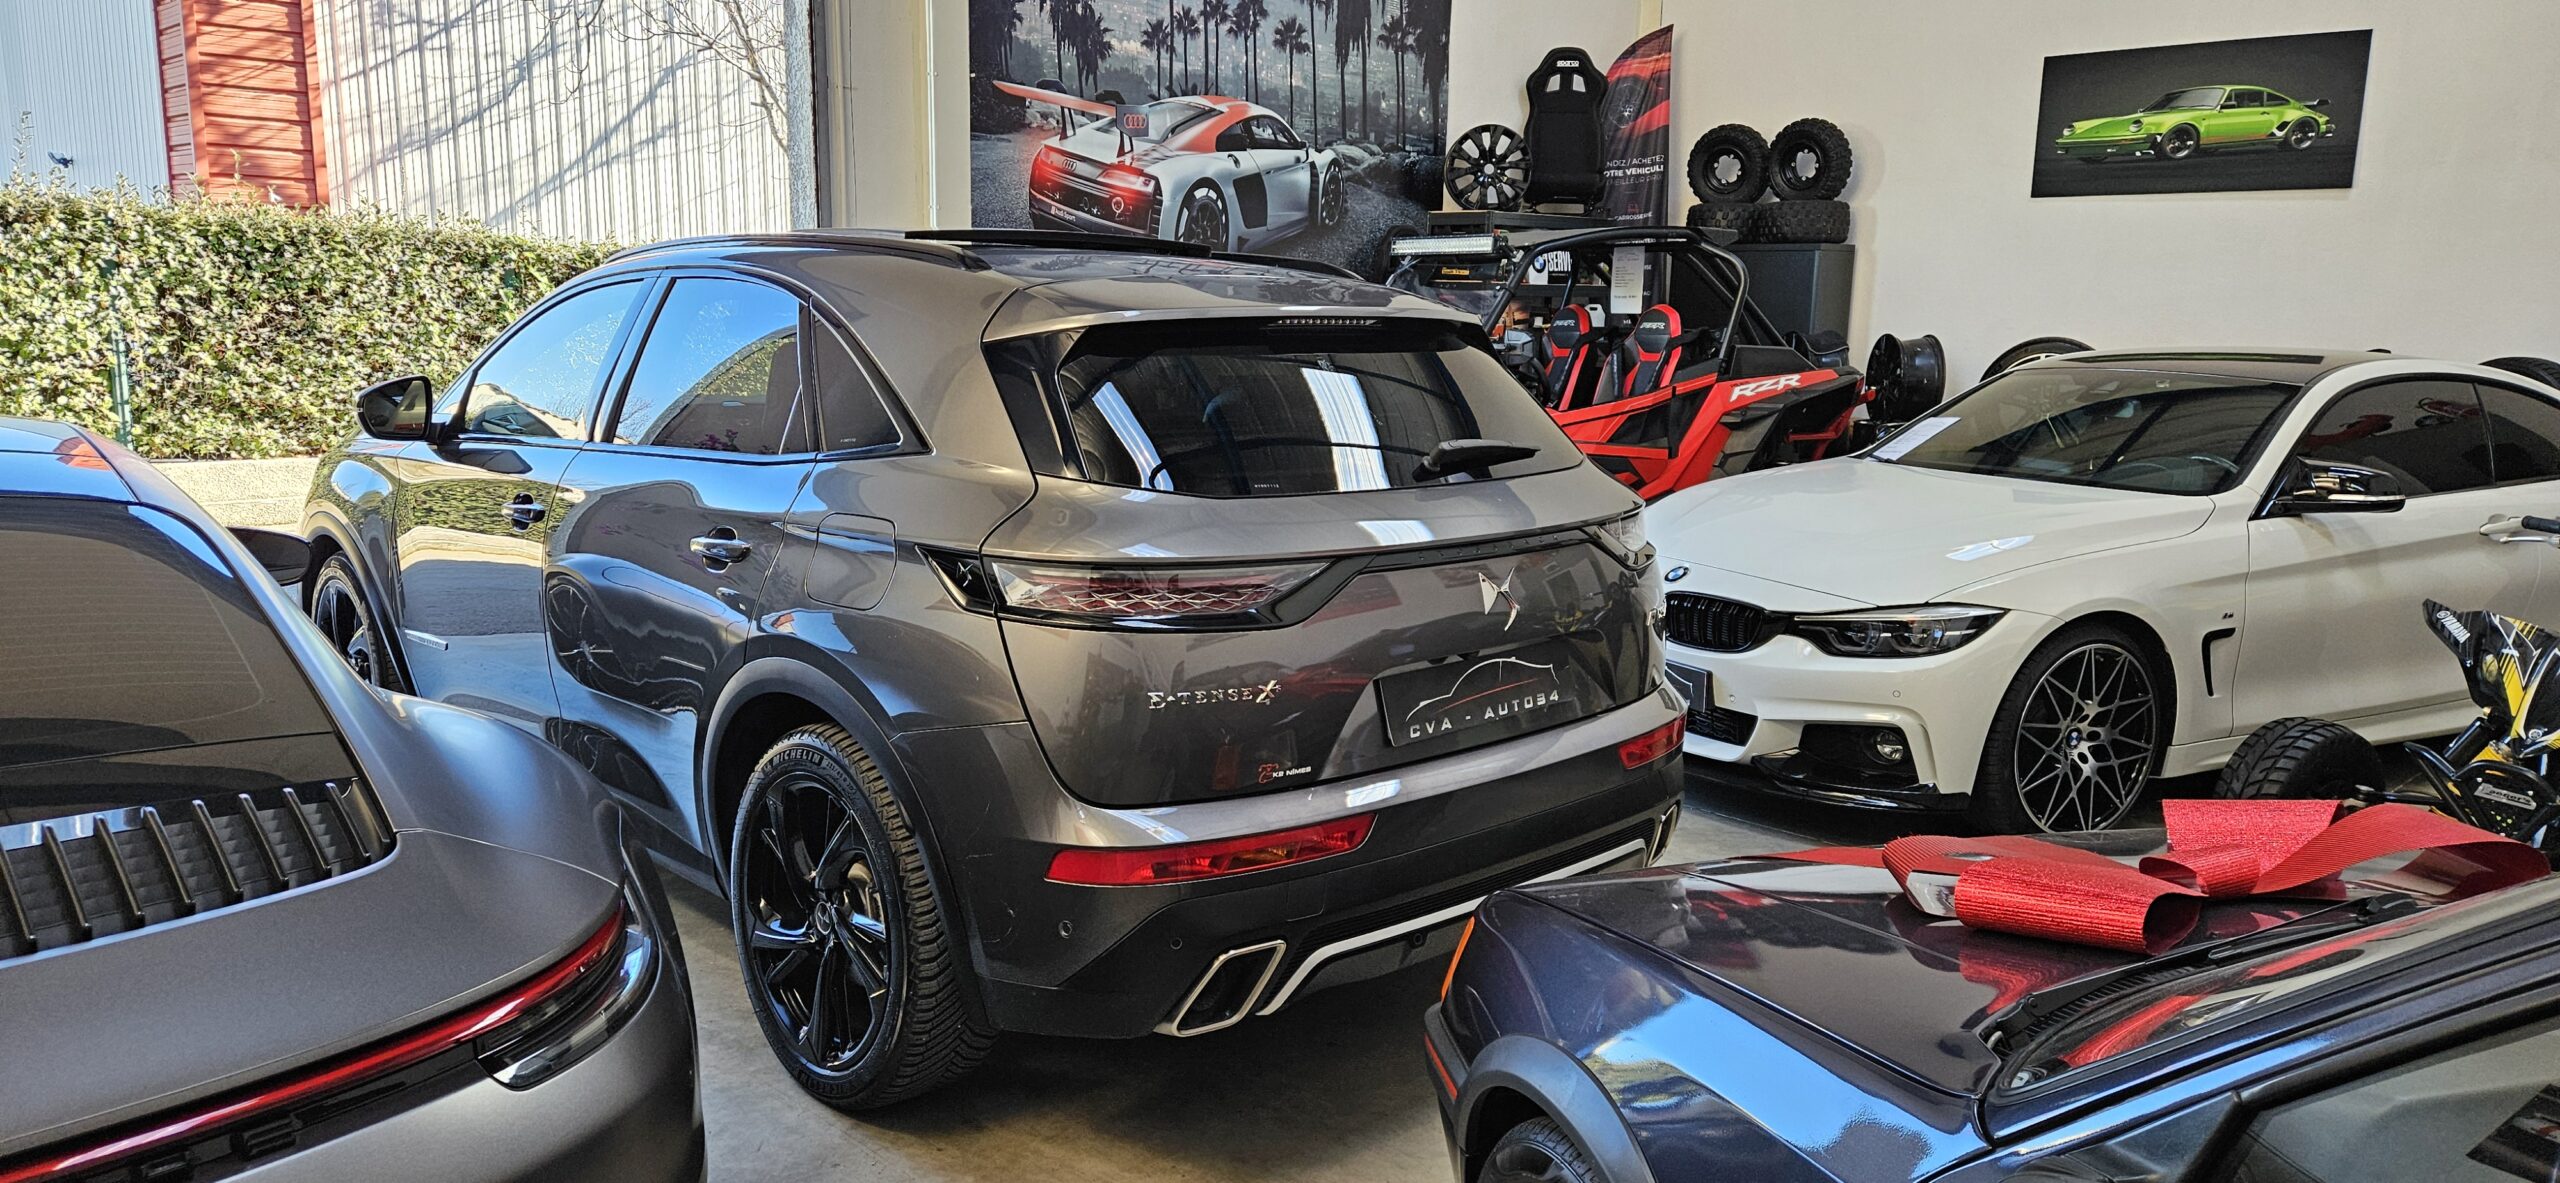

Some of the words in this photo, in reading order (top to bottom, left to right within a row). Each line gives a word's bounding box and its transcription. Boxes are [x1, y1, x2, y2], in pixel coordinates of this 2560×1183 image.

[1604, 169, 1624, 178] OTRE
[1605, 159, 1626, 168] NDEZ
[1548, 251, 1572, 272] SERVI
[1729, 373, 1802, 403] RZR
[2441, 614, 2471, 644] YAMAHA
[1410, 717, 1452, 738] CVA
[773, 749, 821, 768] MICHELIN
